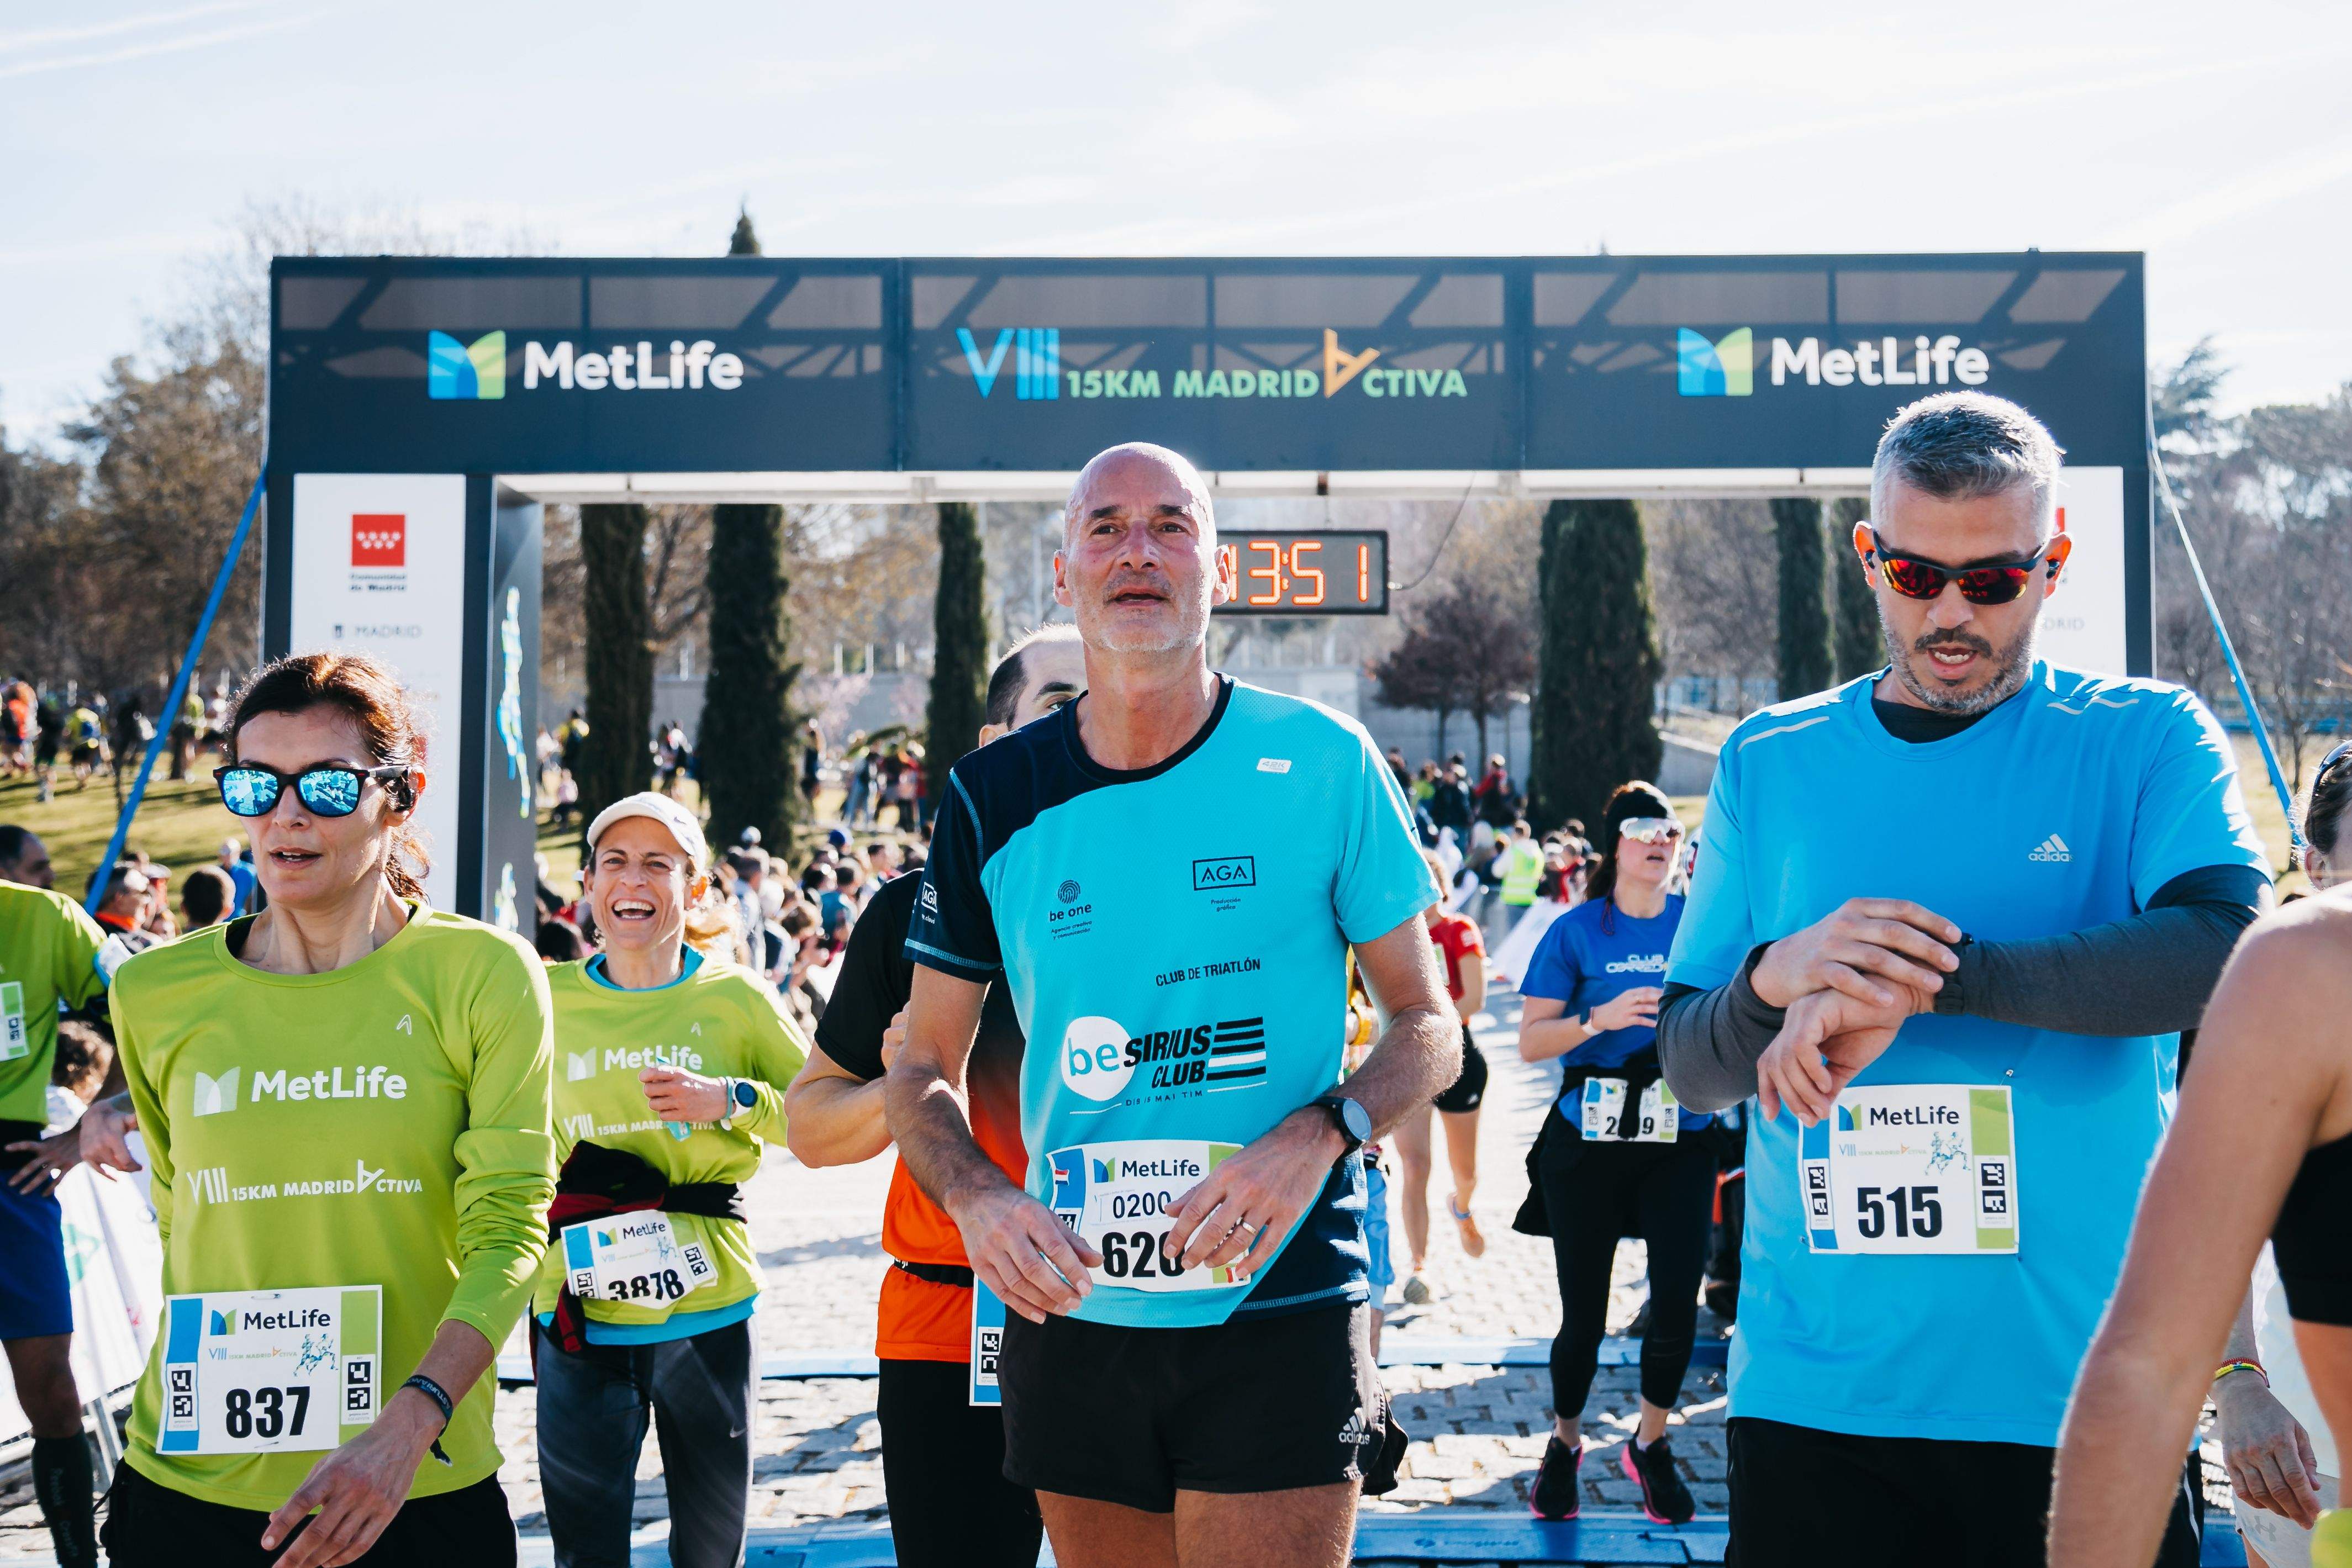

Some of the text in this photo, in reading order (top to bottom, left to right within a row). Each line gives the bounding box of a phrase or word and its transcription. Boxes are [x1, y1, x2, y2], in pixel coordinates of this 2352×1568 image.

[524, 340, 744, 390] MetLife
[956, 328, 1059, 400] VIII
[1067, 369, 1161, 398] 15KM
[1173, 369, 1320, 398] MADRID
[1771, 335, 1989, 386] MetLife
[354, 624, 423, 638] MADRID
[2044, 617, 2085, 631] DRID
[1201, 864, 1248, 883] AGA
[1050, 902, 1092, 922] be one
[1156, 957, 1261, 987] CLUB DE TRIATLÓN
[1067, 1024, 1213, 1077] be SIRIUS
[251, 1065, 407, 1102] MetLife
[1151, 1059, 1206, 1090] CLUB
[563, 1113, 595, 1139] VIII
[597, 1123, 627, 1136] 15KM
[1870, 1105, 1960, 1126] MetLife
[1838, 1143, 1857, 1157] VIII
[1121, 1159, 1200, 1178] MetLife
[186, 1166, 229, 1205] VIII
[232, 1184, 277, 1202] 15KM
[283, 1179, 355, 1196] MADRID
[1857, 1185, 1943, 1239] 515
[622, 1222, 666, 1240] MetLife
[244, 1308, 331, 1331] MetLife
[208, 1347, 228, 1360] VIII
[225, 1386, 310, 1439] 837
[1338, 1430, 1370, 1445] adidas
